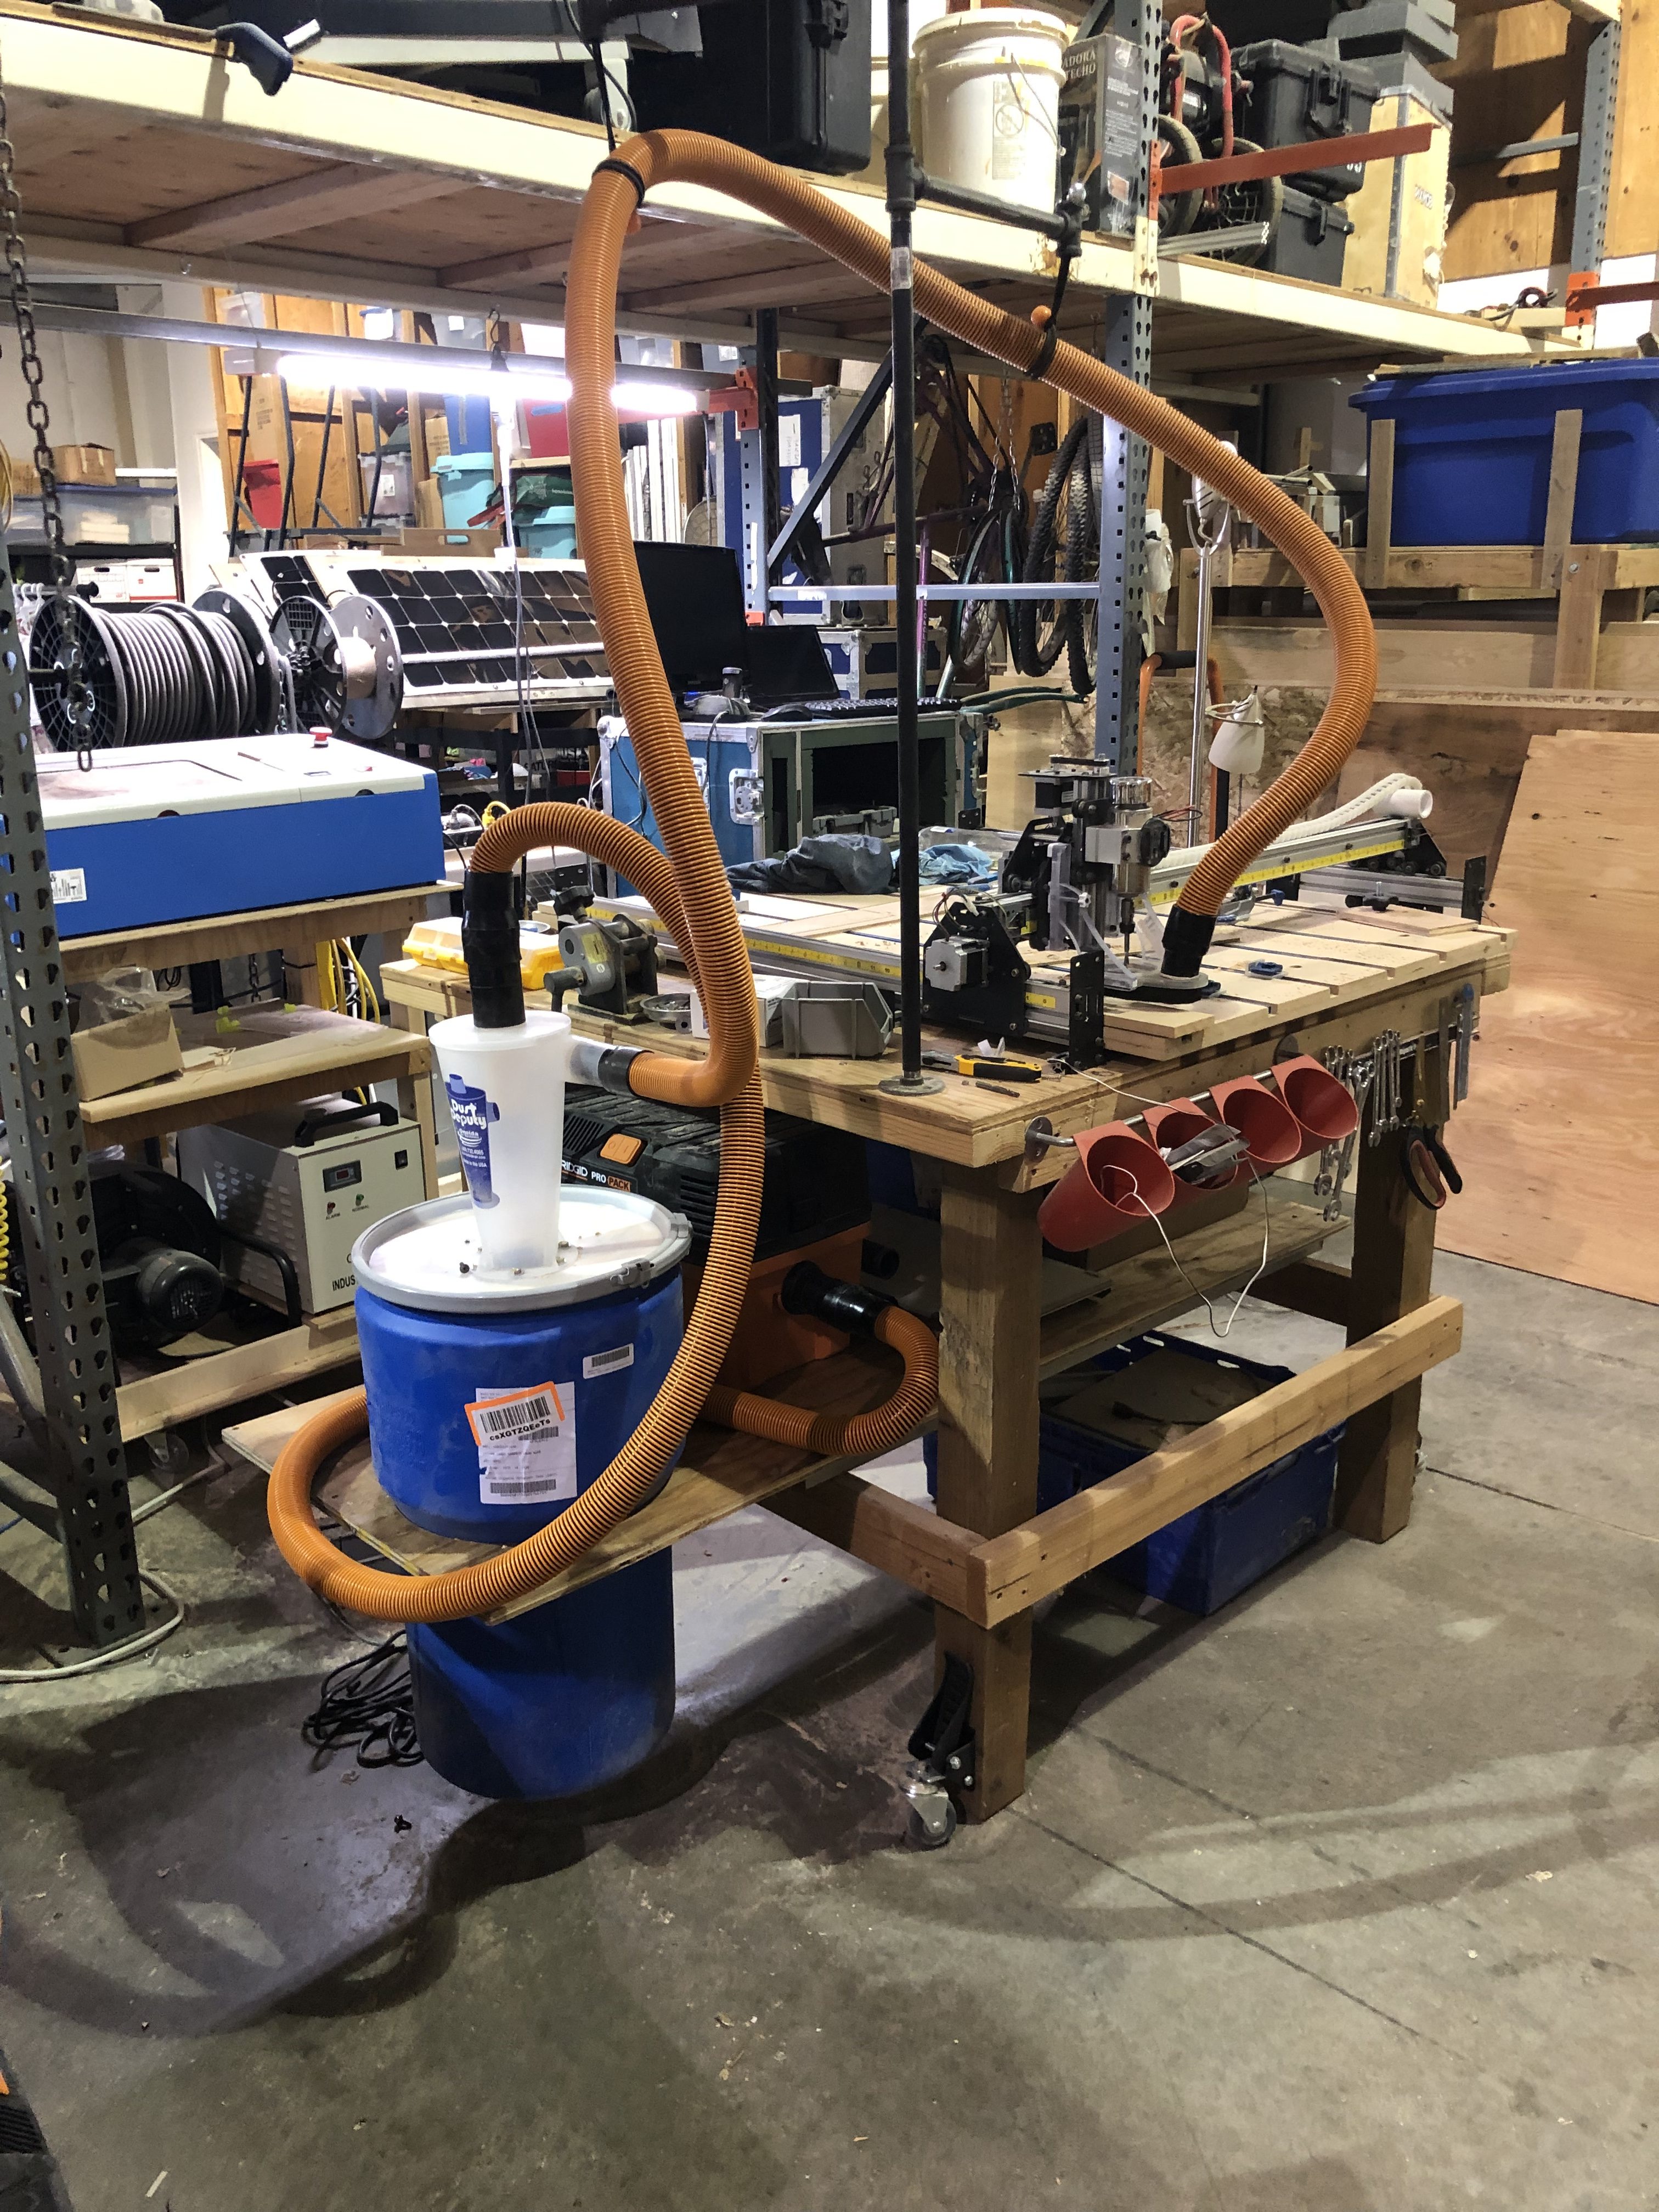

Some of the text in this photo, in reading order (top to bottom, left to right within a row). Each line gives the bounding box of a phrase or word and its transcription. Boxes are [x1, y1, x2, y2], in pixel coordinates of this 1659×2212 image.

[451, 1098, 477, 1115] Dust
[450, 1107, 487, 1130] Deputy
[562, 1159, 629, 1192] RIDGID PRO PACK
